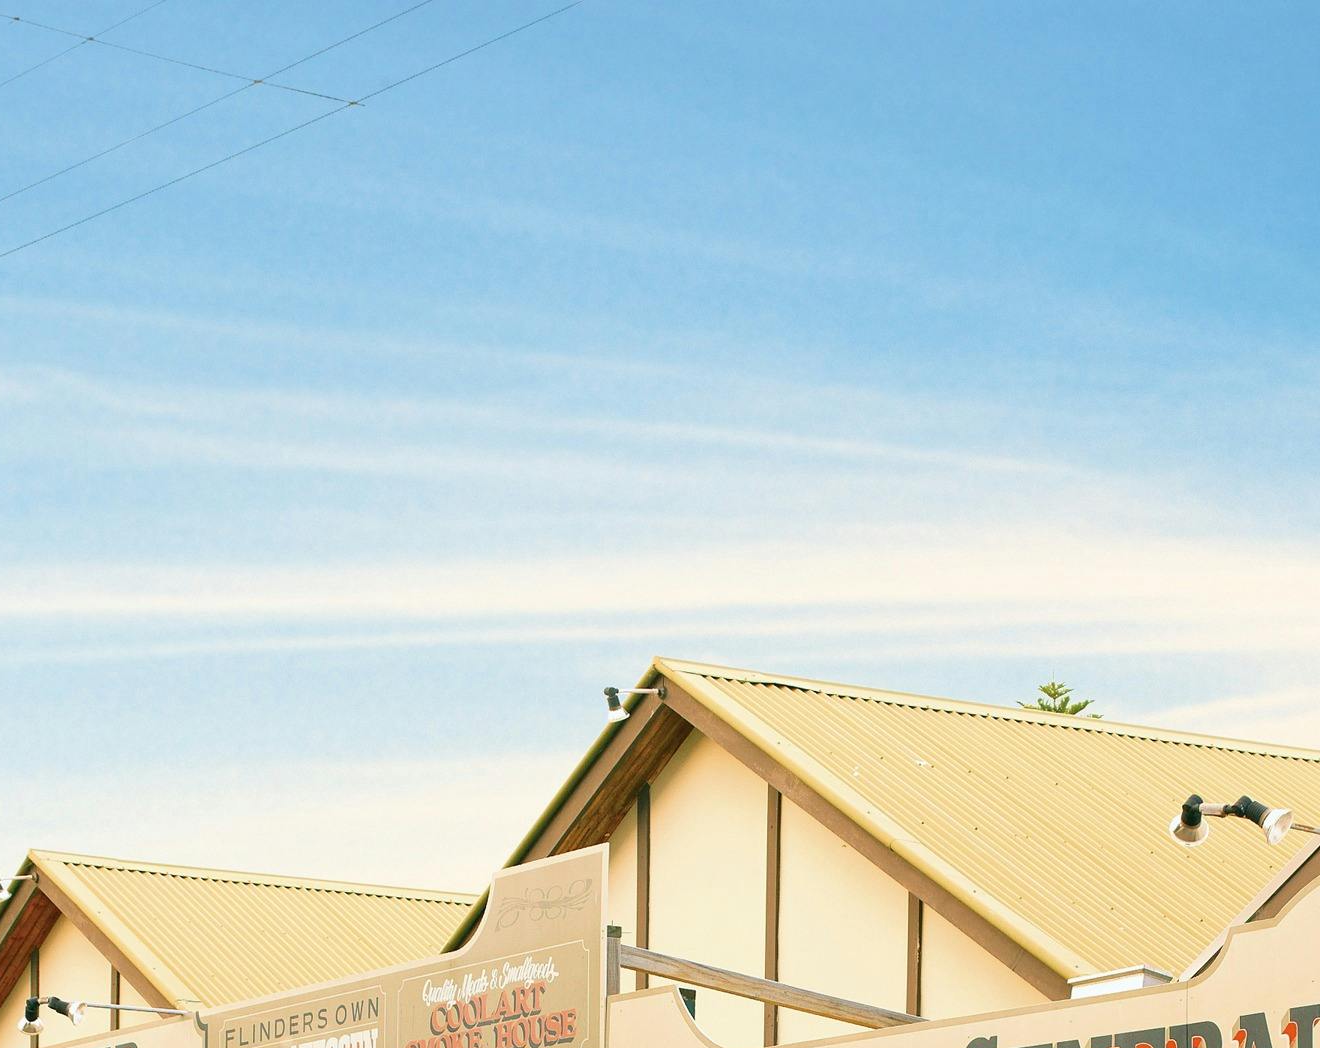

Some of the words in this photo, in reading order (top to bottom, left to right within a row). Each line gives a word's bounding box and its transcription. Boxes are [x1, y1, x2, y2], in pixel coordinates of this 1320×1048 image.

[422, 978, 458, 1007] Quality
[457, 973, 489, 1003] Meats
[490, 970, 499, 990] &
[498, 956, 560, 987] Smallgoods
[225, 1010, 329, 1048] FLINDERS
[334, 996, 379, 1028] OWN
[430, 981, 547, 1035] COOLART
